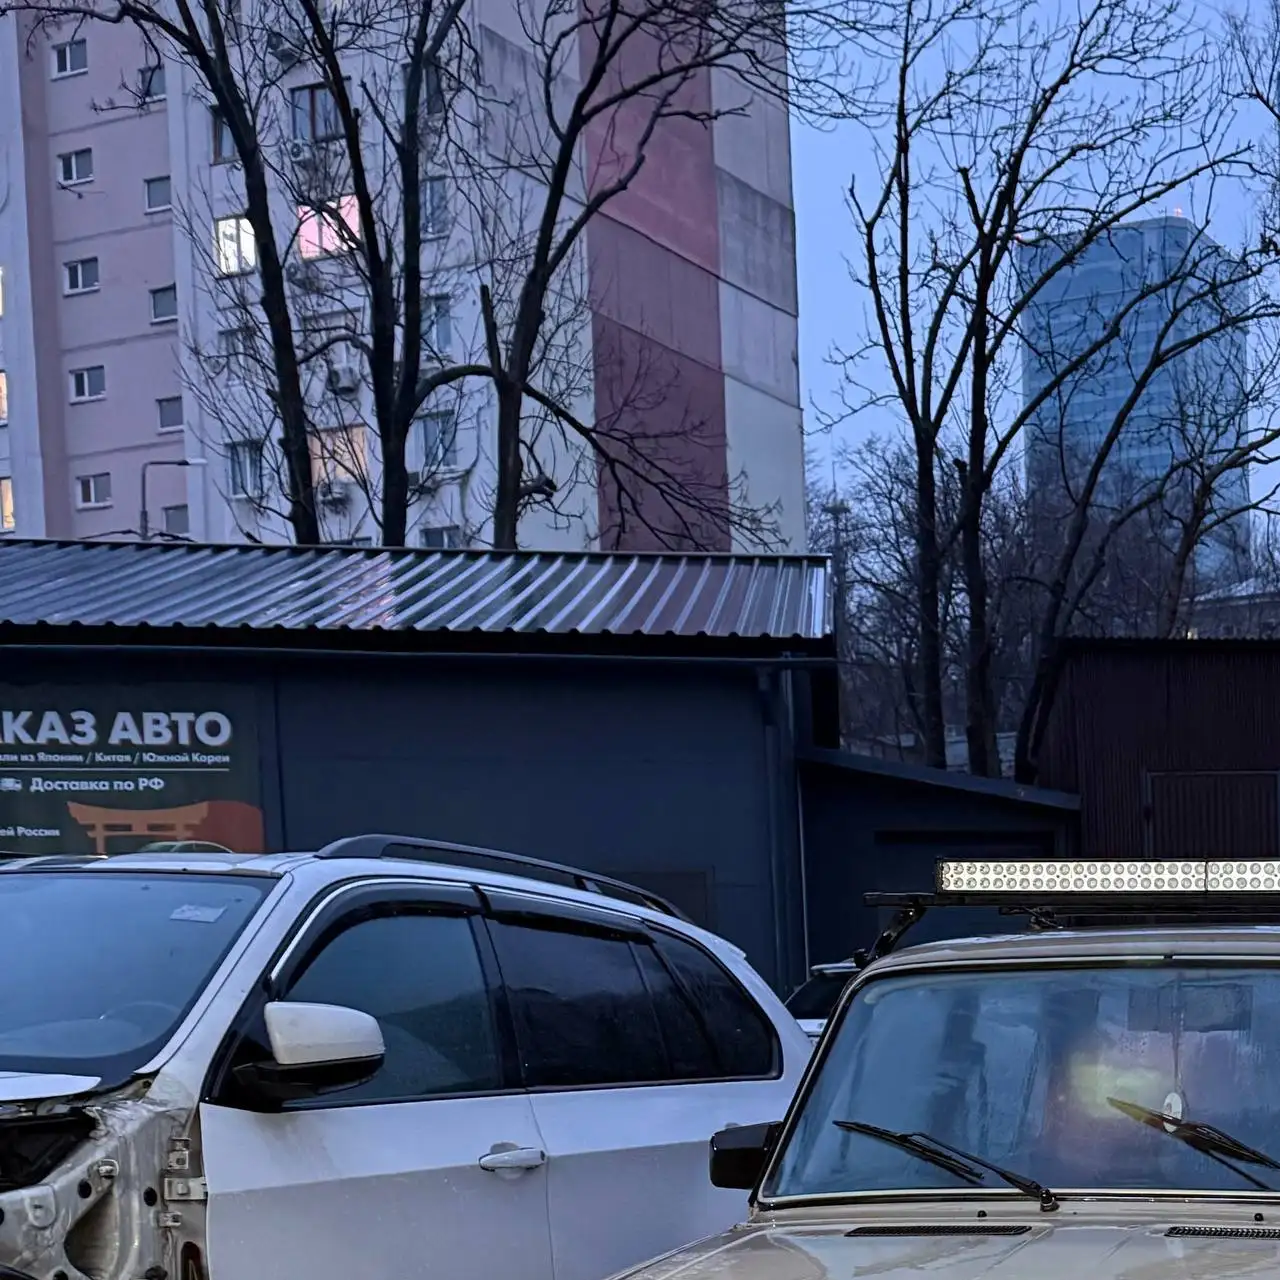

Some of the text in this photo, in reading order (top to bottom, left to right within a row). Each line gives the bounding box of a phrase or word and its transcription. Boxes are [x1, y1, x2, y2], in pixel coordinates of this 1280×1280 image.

[0, 710, 232, 746] КАЗ АВТО
[37, 752, 83, 763] Японии
[95, 752, 131, 763] Китая
[142, 752, 190, 763] Южной
[192, 753, 230, 765] Кореи
[30, 777, 165, 792] Доставка по РФ
[17, 827, 60, 837] России
